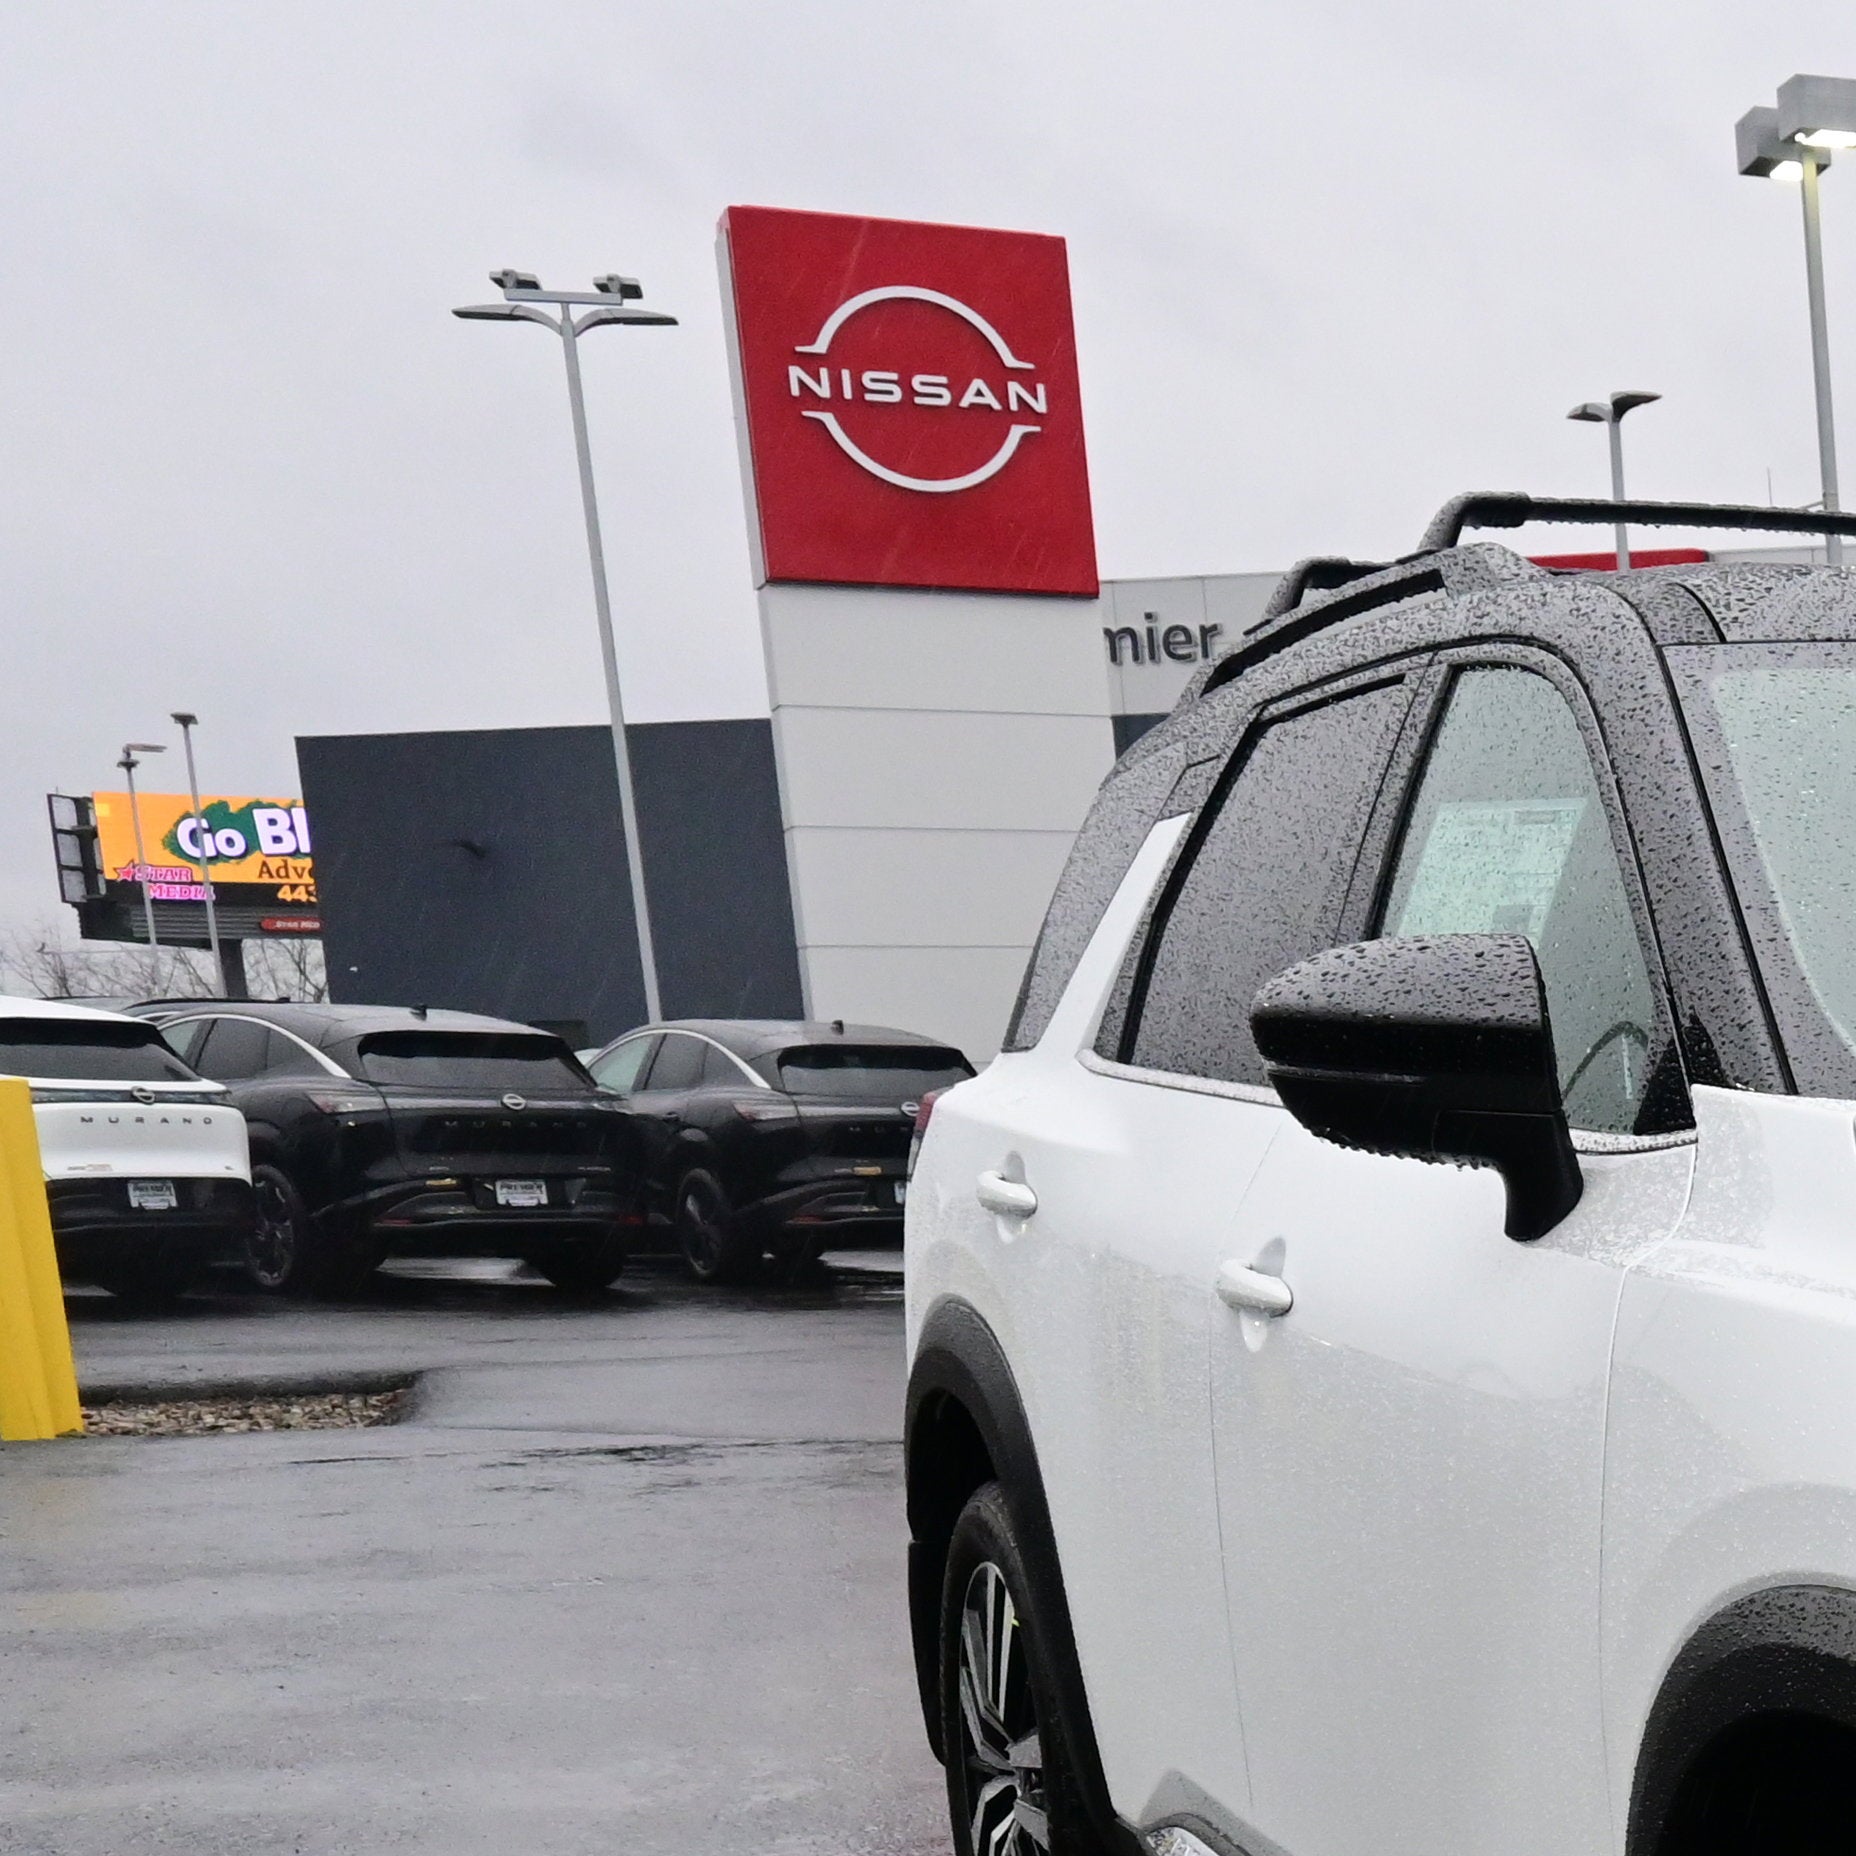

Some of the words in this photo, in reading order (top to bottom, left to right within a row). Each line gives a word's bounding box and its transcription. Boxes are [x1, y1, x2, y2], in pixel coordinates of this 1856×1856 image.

[788, 364, 1047, 414] NISSAN
[176, 816, 246, 858] Go
[80, 1116, 213, 1125] MURANO
